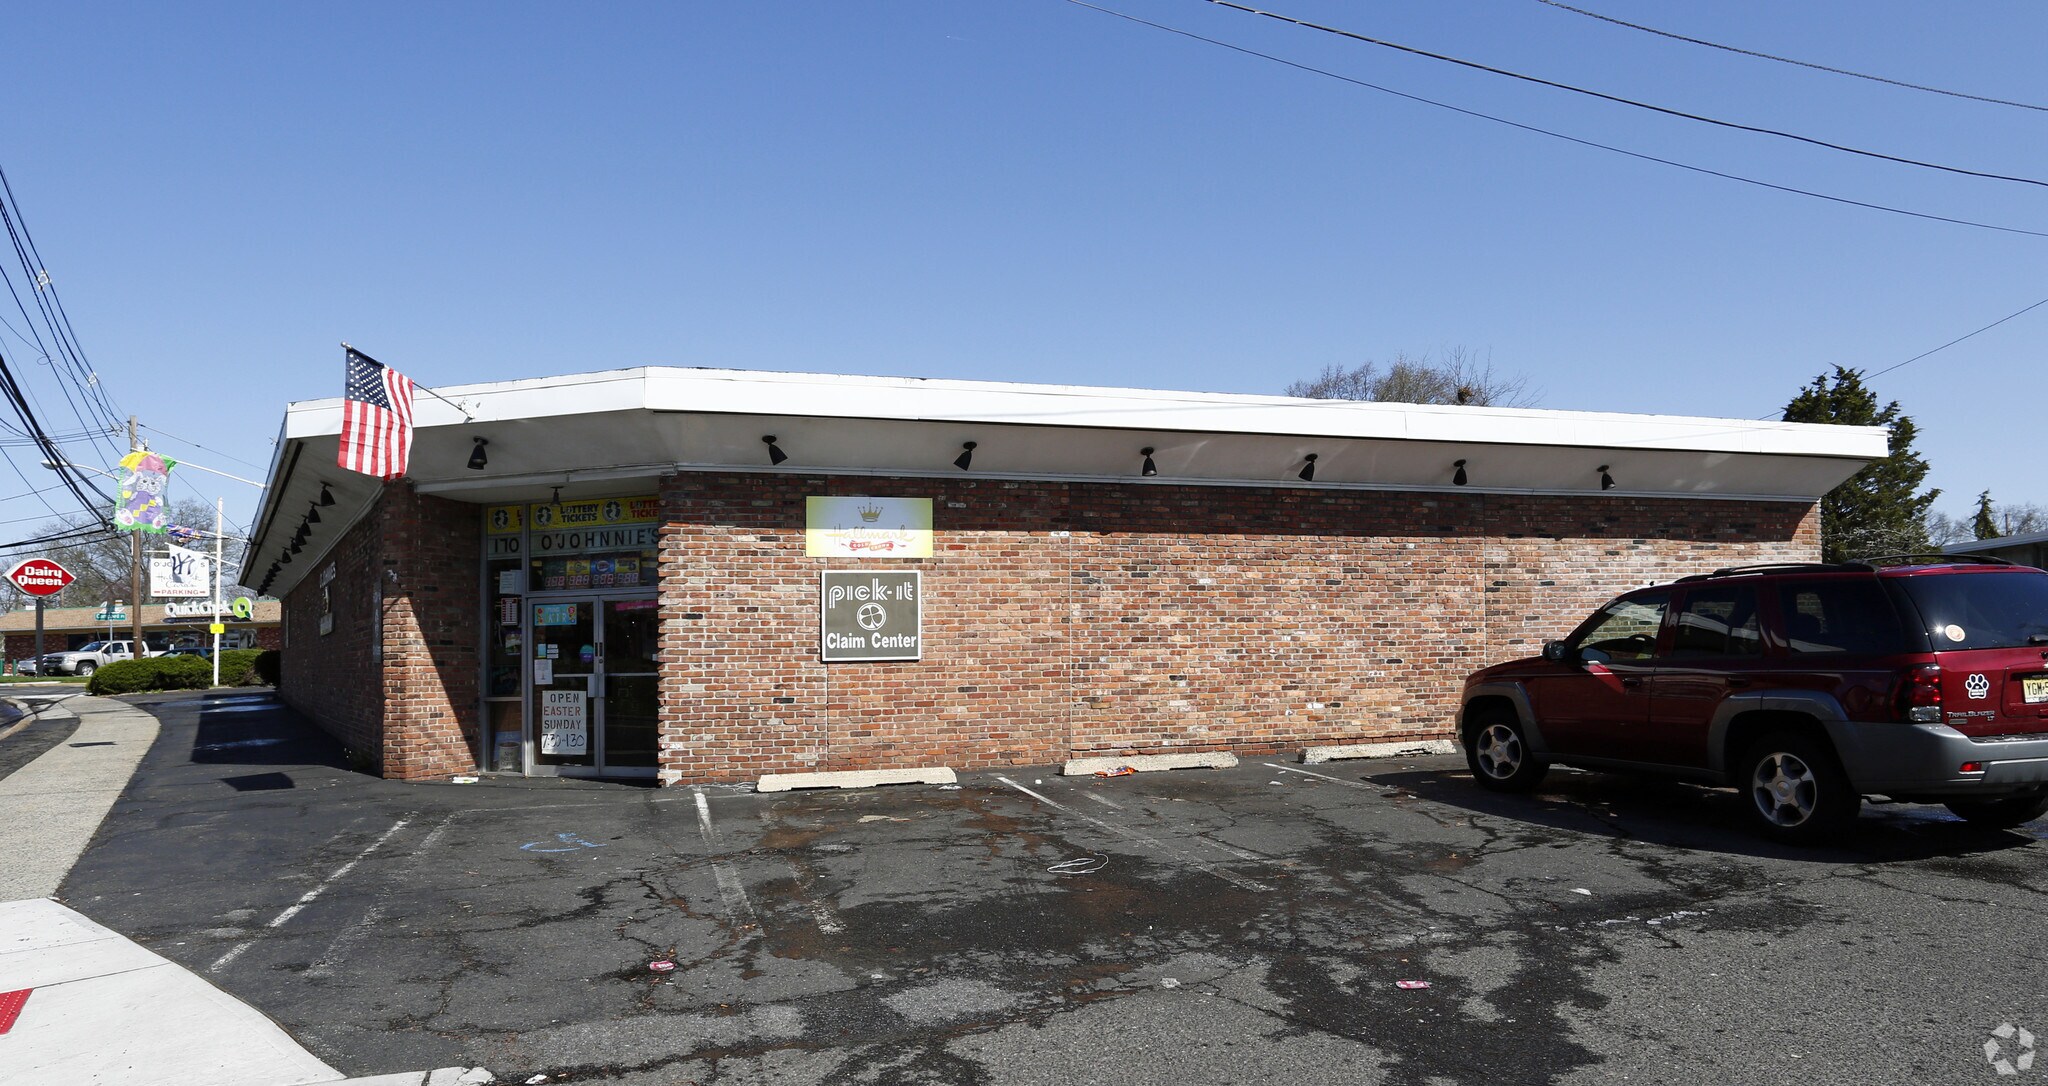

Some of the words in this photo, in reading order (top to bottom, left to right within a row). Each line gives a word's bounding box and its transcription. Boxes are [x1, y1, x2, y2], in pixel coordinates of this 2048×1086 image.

[560, 503, 599, 515] LOTTERY
[561, 512, 598, 523] TICKETS
[541, 528, 658, 551] O'JOHNNIE'S
[825, 523, 916, 546] Hallmark
[25, 566, 62, 578] Dairy
[829, 578, 913, 609] pick-it
[826, 632, 865, 649] Claim
[871, 632, 917, 649] Center
[550, 693, 579, 703] OPEN
[543, 706, 581, 717] EASTER
[543, 719, 582, 730] SUNDAY
